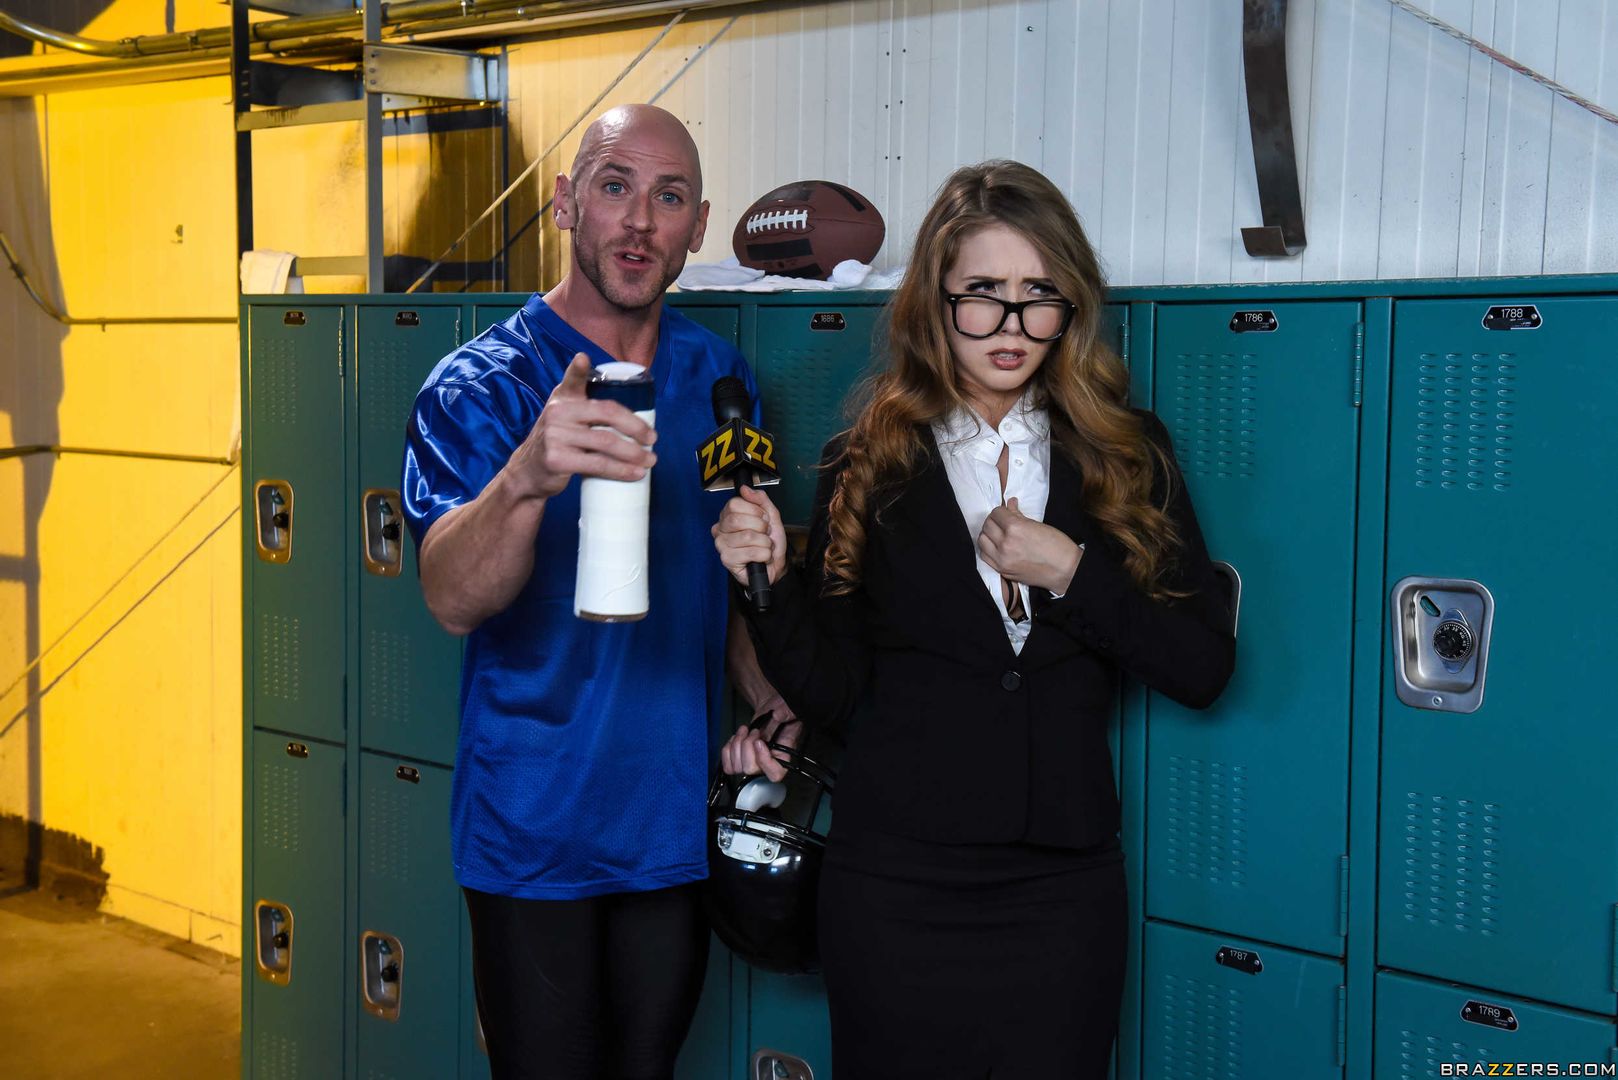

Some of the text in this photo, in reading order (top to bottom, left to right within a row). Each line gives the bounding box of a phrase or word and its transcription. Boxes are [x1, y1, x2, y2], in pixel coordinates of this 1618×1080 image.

[1245, 313, 1263, 322] 1786
[1501, 308, 1523, 318] 1788
[744, 427, 777, 470] ZZ
[701, 428, 736, 481] ZZ
[1230, 950, 1247, 960] 1787
[1479, 1005, 1500, 1017] 1789
